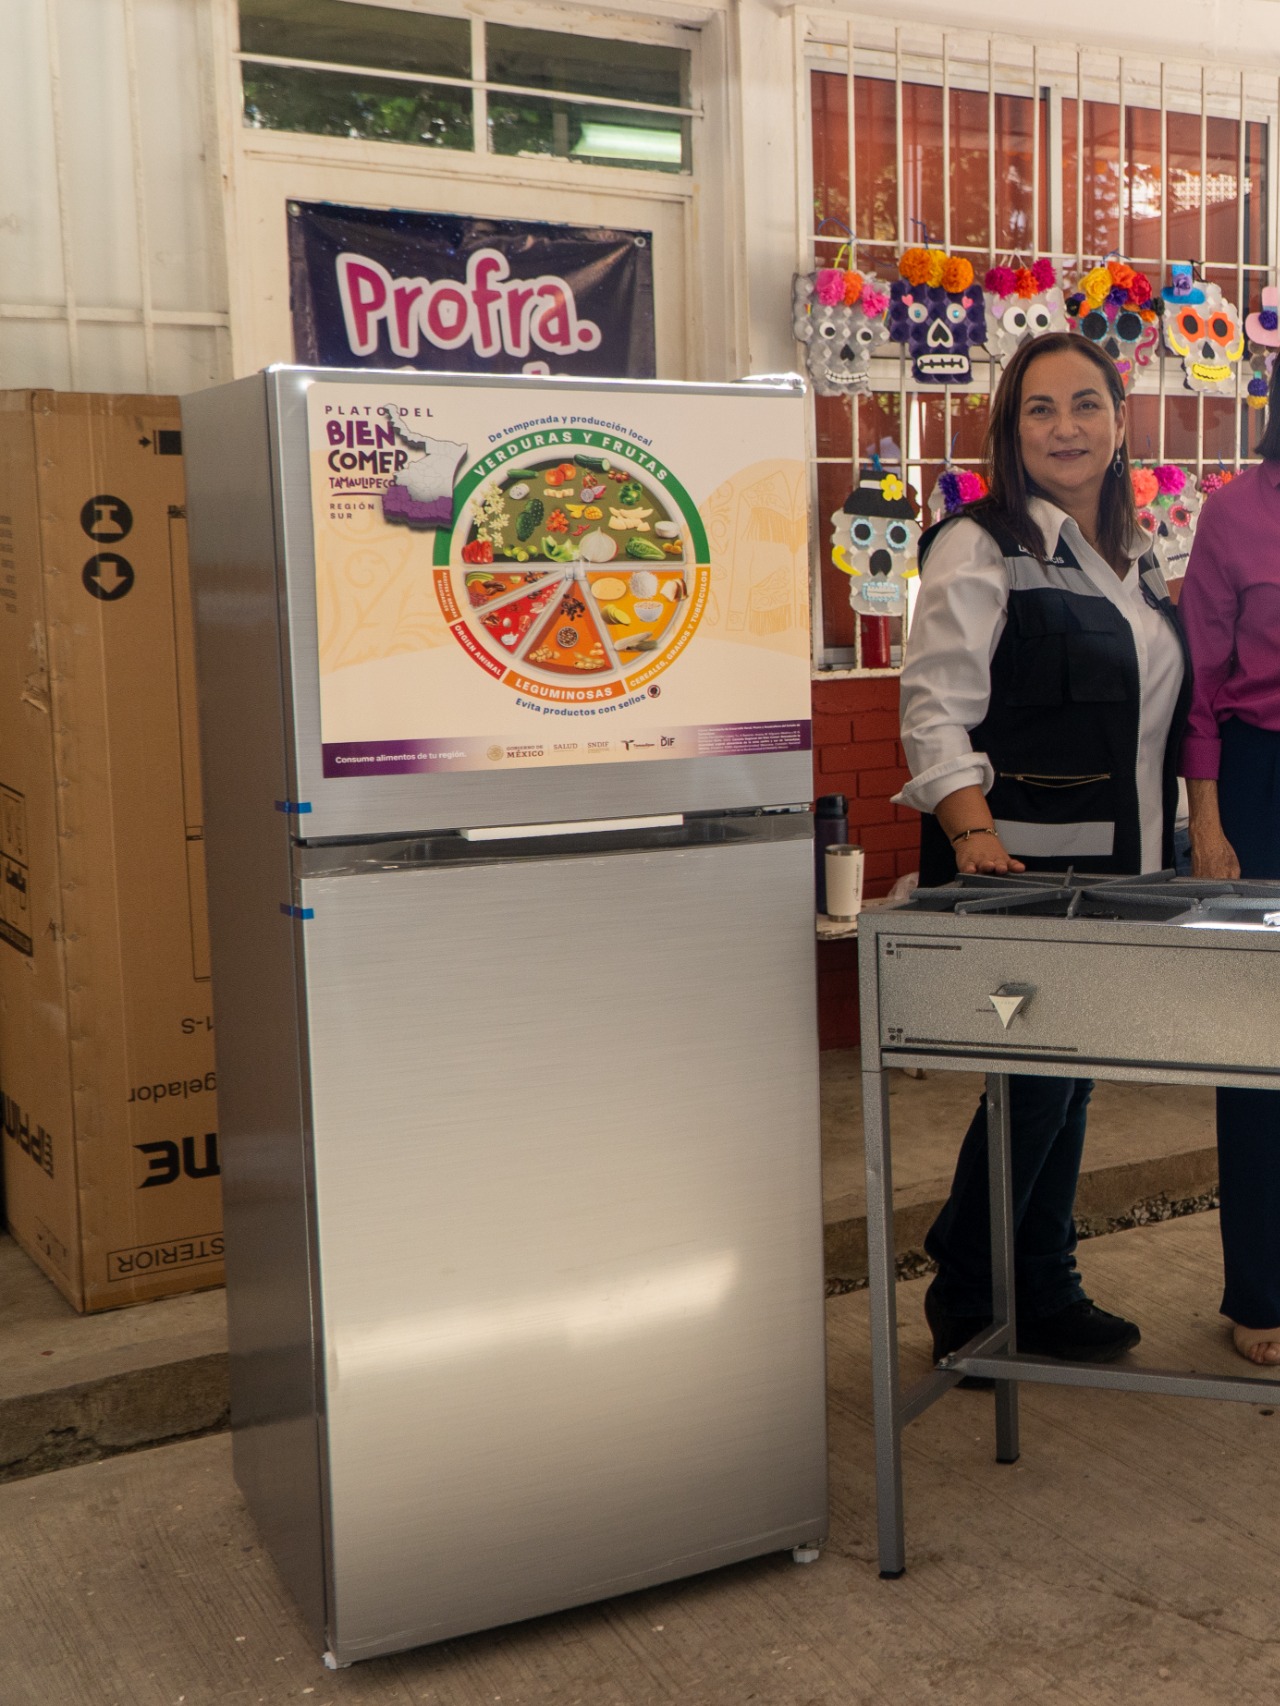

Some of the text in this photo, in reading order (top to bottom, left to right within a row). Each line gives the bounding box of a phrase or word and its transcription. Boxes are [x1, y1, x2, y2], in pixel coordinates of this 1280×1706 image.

[338, 250, 600, 357] Profra.
[325, 405, 434, 418] PLATO DEL
[326, 420, 396, 450] BIEN
[488, 415, 653, 447] De temporada y producción local
[328, 450, 409, 475] COMER
[474, 432, 667, 481] VERDURAS Y FRUTAS
[329, 477, 397, 490] TAMAULIPECO
[330, 502, 375, 511] REGIÓN
[629, 660, 668, 687] CEREALES,
[666, 631, 691, 660] GRANOS
[691, 571, 708, 623] TUBÉRCULOS
[474, 652, 502, 676] ANIMAL
[515, 678, 613, 700] LEGUMINOSAS
[515, 694, 646, 717] Evita productos con sellos
[335, 755, 375, 764] Consume
[376, 753, 416, 762] alimentos
[417, 752, 428, 760] de
[438, 751, 467, 761] región.
[506, 749, 544, 758] MÉXICO
